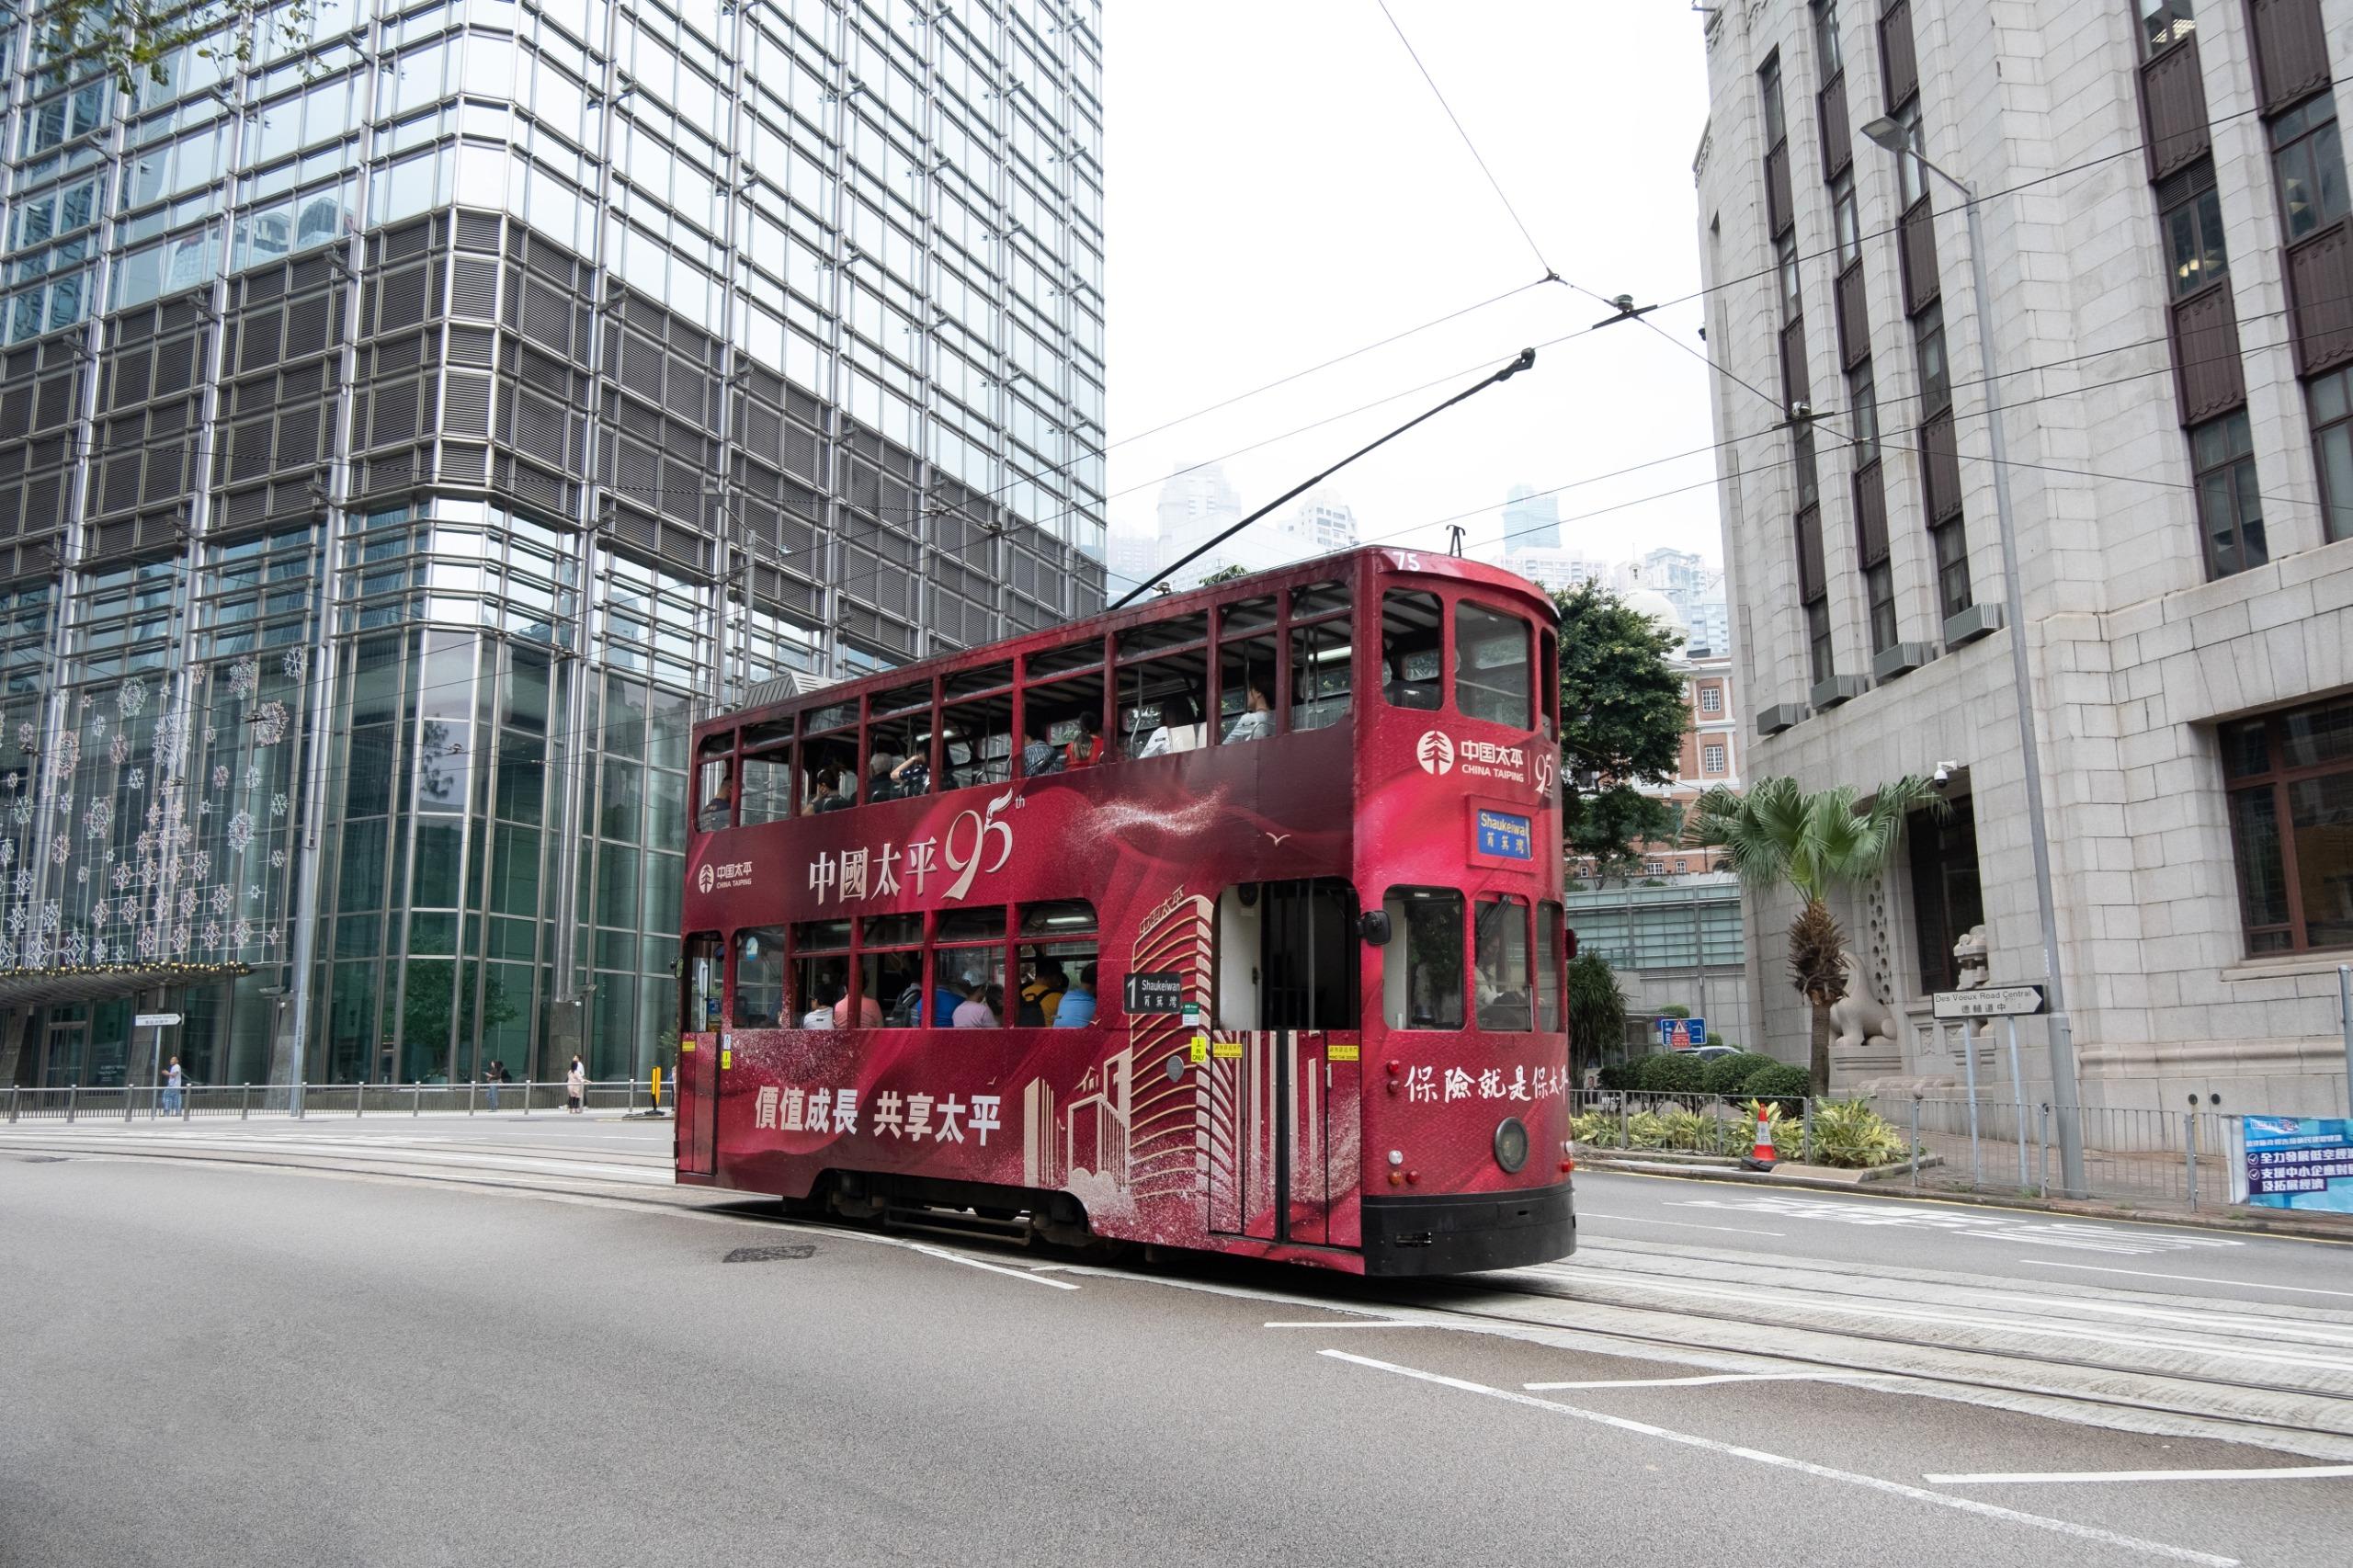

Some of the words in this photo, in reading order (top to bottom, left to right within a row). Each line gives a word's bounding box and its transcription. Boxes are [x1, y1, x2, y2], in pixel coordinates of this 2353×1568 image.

[1392, 551, 1420, 572] 75
[1461, 740, 1524, 768] 中国太平
[1461, 764, 1491, 777] CHINA
[1493, 768, 1524, 783] TAIPING
[717, 861, 752, 880] 中国太平
[809, 835, 938, 905] 中國太平
[716, 881, 731, 889] CHINA
[733, 878, 752, 887] TAIPING
[1127, 976, 1137, 1009] 1
[1142, 979, 1180, 992] Shaukeiwan
[1935, 994, 1950, 1003] Des
[1952, 994, 1977, 1002] Voeux
[1979, 992, 2001, 1000] Road
[2002, 990, 2031, 998] Central
[756, 1085, 858, 1134] 價值成長
[873, 1090, 1001, 1146] 共享太平
